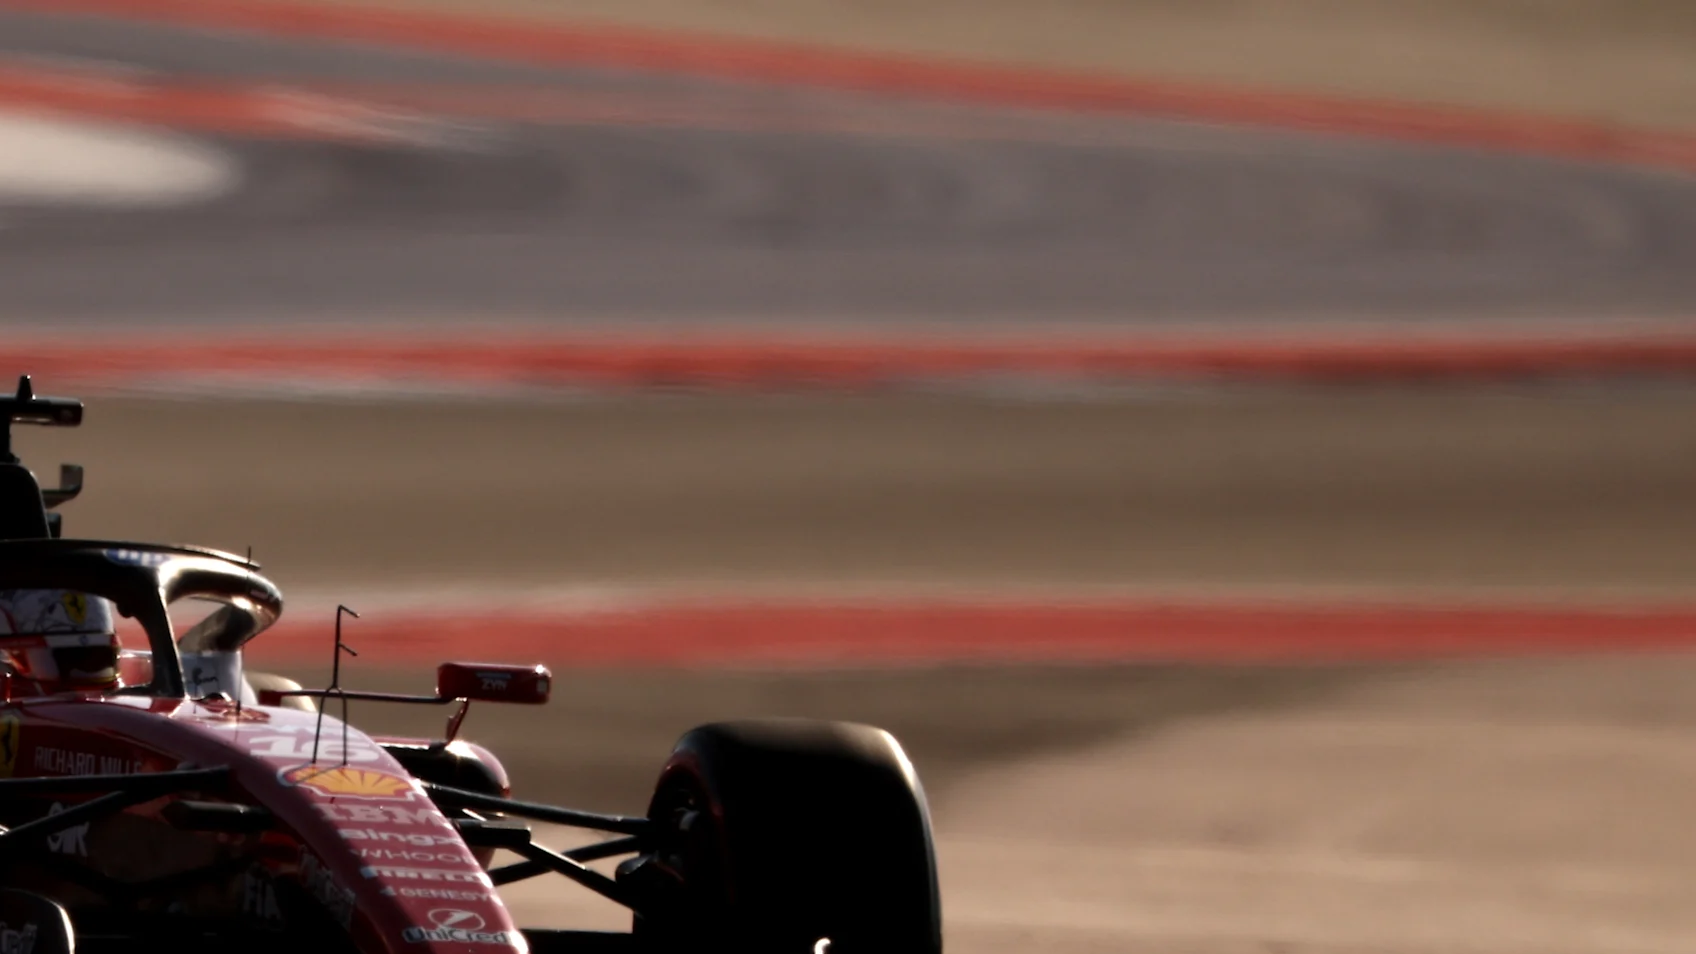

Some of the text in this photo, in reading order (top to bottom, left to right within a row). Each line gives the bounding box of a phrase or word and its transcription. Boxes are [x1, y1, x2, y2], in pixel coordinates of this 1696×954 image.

[34, 745, 96, 775] RICHARD
[249, 735, 379, 762] 16
[315, 803, 454, 830] IBM
